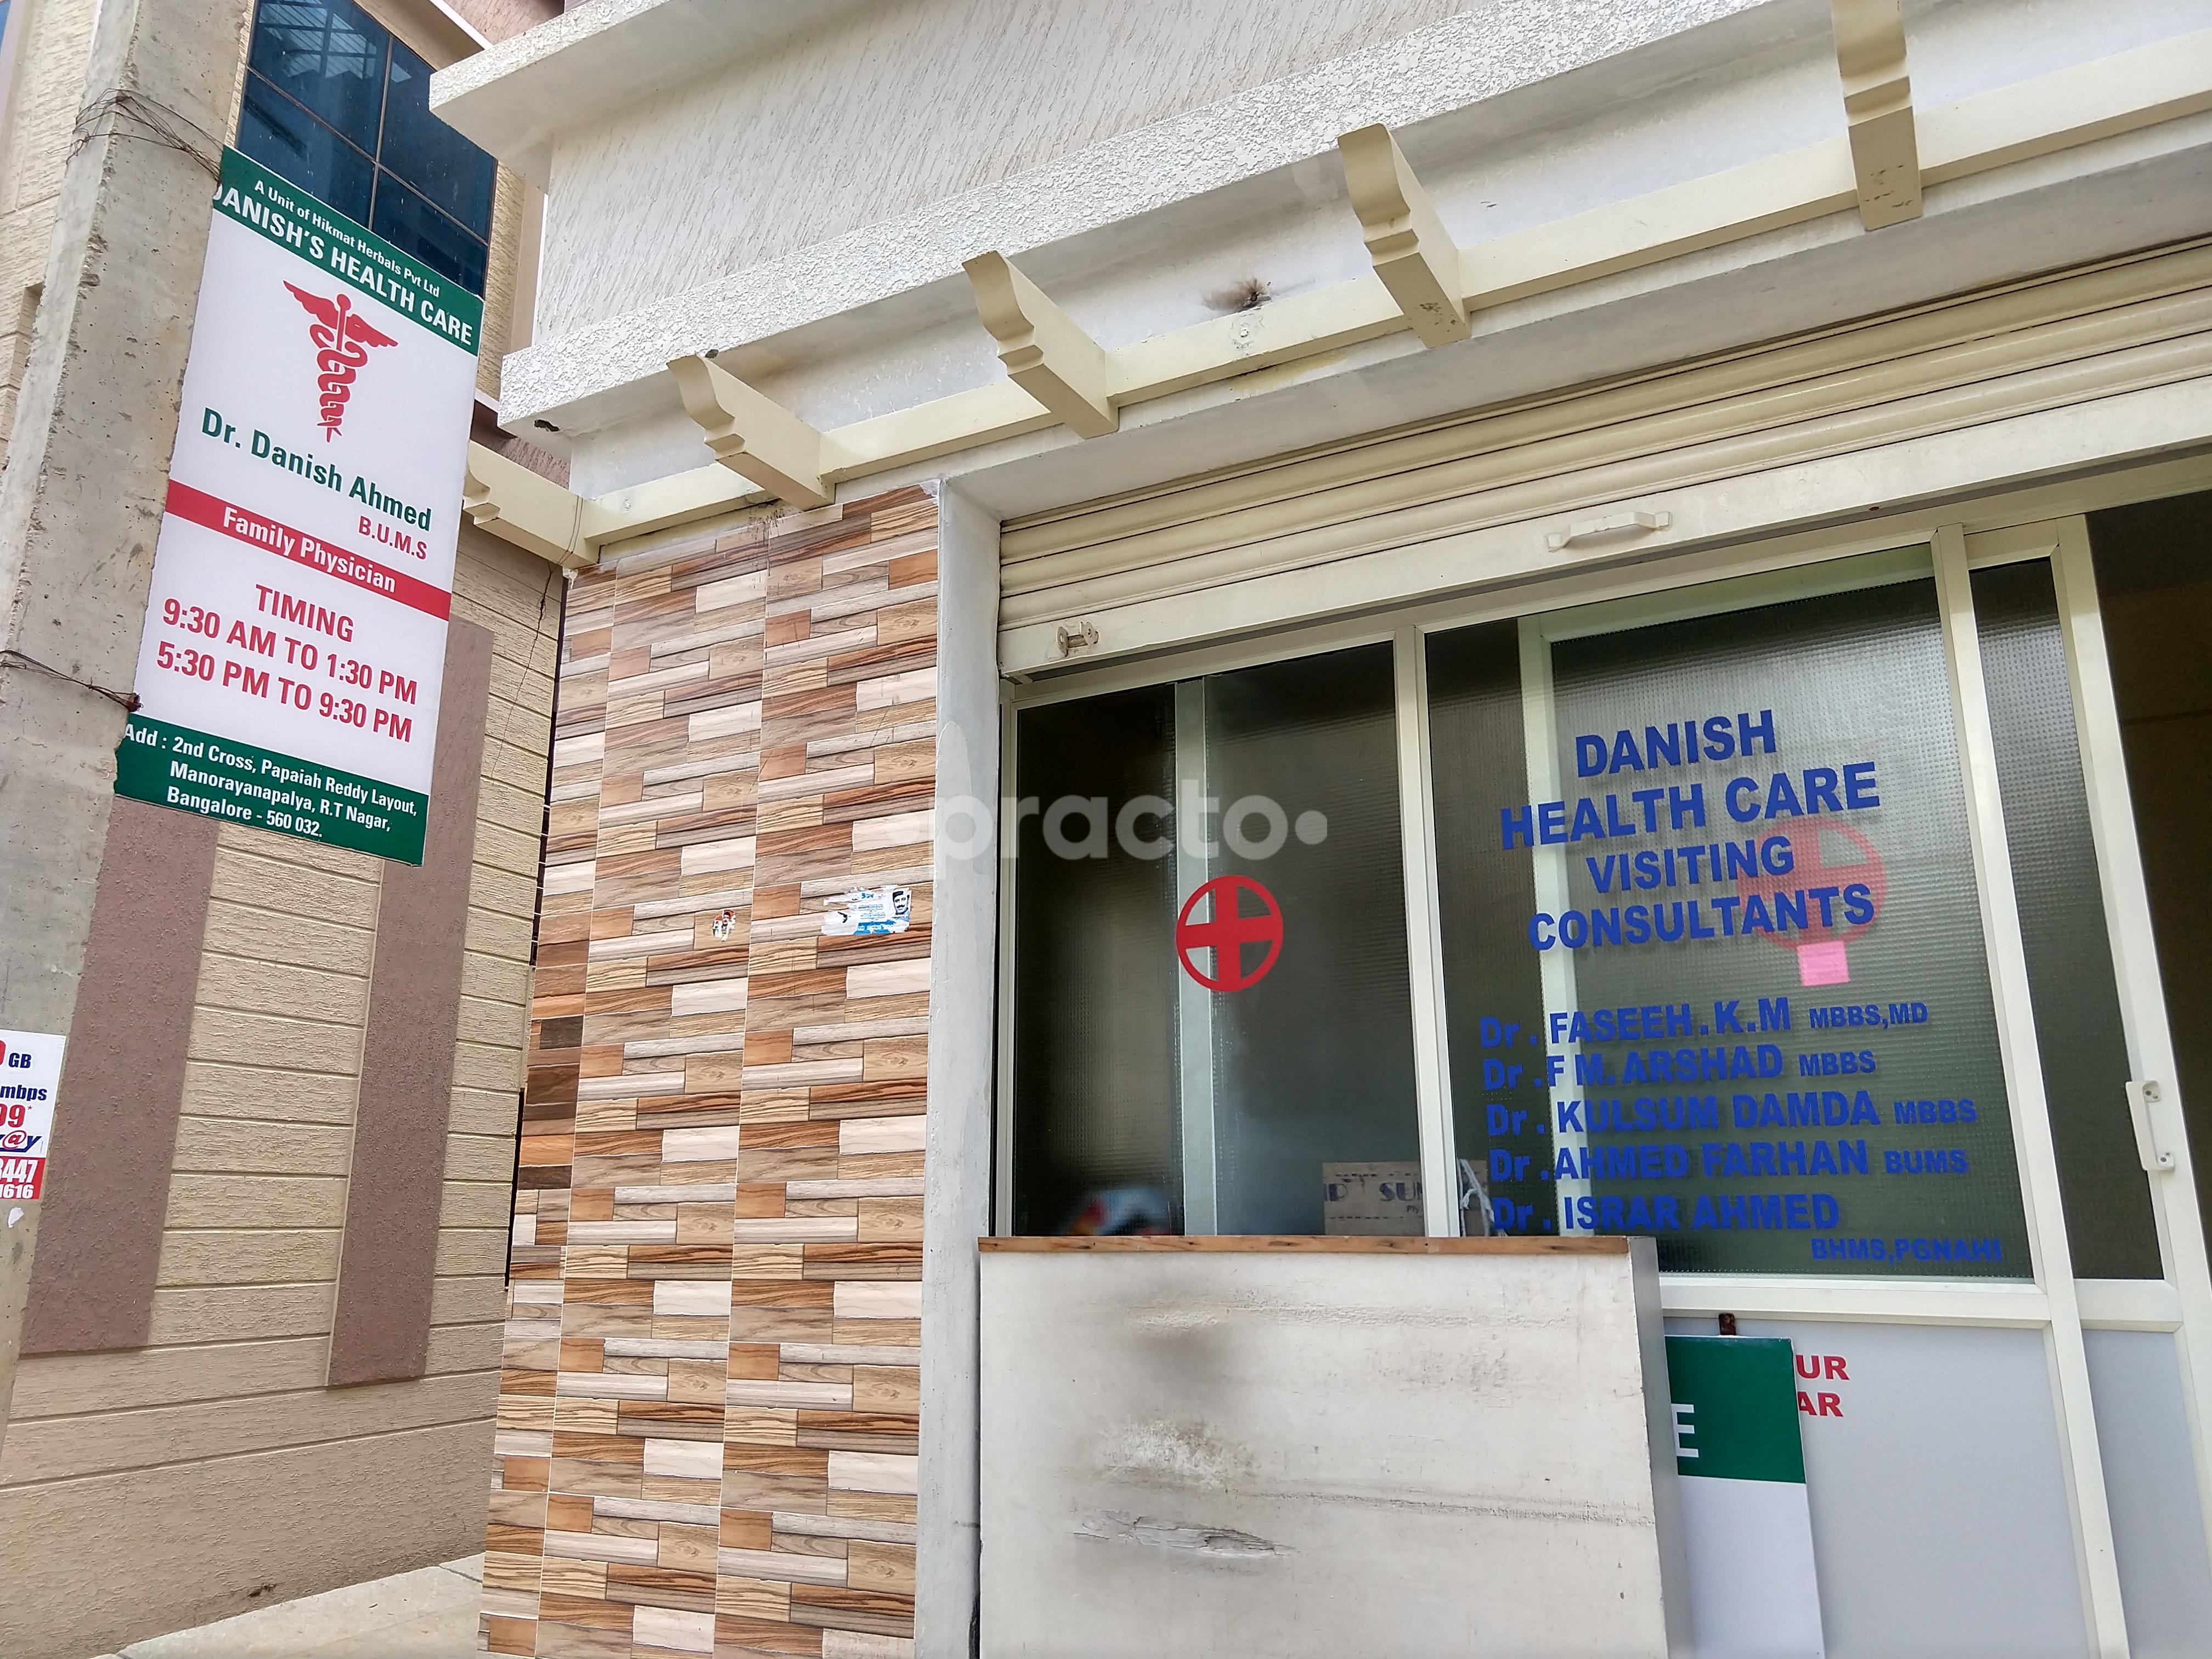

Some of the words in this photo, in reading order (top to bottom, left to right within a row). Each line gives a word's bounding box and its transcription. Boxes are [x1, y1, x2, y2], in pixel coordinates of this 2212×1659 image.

[254, 180, 264, 195] A
[268, 187, 295, 212] Unit
[297, 207, 311, 221] of
[312, 212, 355, 247] Hikmat
[357, 240, 402, 275] Herbals
[404, 267, 422, 288] Pvt
[423, 278, 440, 297] Ltd
[331, 246, 414, 312] HEALTH
[421, 302, 473, 346] CARE
[201, 407, 241, 448] Dr.
[251, 428, 343, 492] Danish
[348, 476, 432, 531] Ahmed
[223, 507, 295, 556] Family
[300, 537, 396, 593] Physician
[359, 517, 427, 560] B.U.M.S
[255, 584, 353, 642] TIMING
[163, 598, 221, 639] 9:30
[226, 620, 274, 657] AM
[284, 636, 318, 670] TO
[327, 653, 371, 689] 1:30
[379, 671, 417, 705] PM
[157, 640, 215, 681] 5:30
[222, 660, 269, 698] PM
[278, 676, 311, 710] TO
[319, 692, 366, 728] 9:30
[374, 714, 412, 743] PM
[123, 724, 158, 747] Add
[172, 736, 203, 758] 2nd
[208, 746, 256, 774] Cross,
[261, 759, 321, 789] Papaiah
[325, 777, 368, 804] Reddy
[371, 788, 417, 816] Layout,
[1575, 710, 1776, 778] DANISH
[166, 786, 251, 821] Bangalore
[267, 810, 292, 830] 560
[295, 818, 322, 837] 032.
[170, 760, 316, 814] Manorayanapalya,
[319, 801, 343, 818] R.T
[346, 808, 392, 832] Nagar,
[1500, 783, 1706, 850] HEALTH
[1725, 761, 1881, 823] CARE
[1587, 836, 1795, 894] VISITING
[1528, 883, 1875, 951] CONSULTANTS
[1809, 1002, 1928, 1029] MBBS,MD
[8, 1052, 32, 1069] GB
[1799, 1050, 1876, 1076] MBBS
[1557, 1095, 1719, 1133] KULSUM
[1732, 1090, 1881, 1128] DAMDA
[1893, 1098, 1978, 1125] MBBS
[1555, 1144, 1689, 1180] AHMED
[1702, 1139, 1869, 1177] FARHAN
[1884, 1149, 1968, 1174] BUMS
[1564, 1195, 1679, 1229] ISRAR
[1692, 1193, 1840, 1229] AHMED
